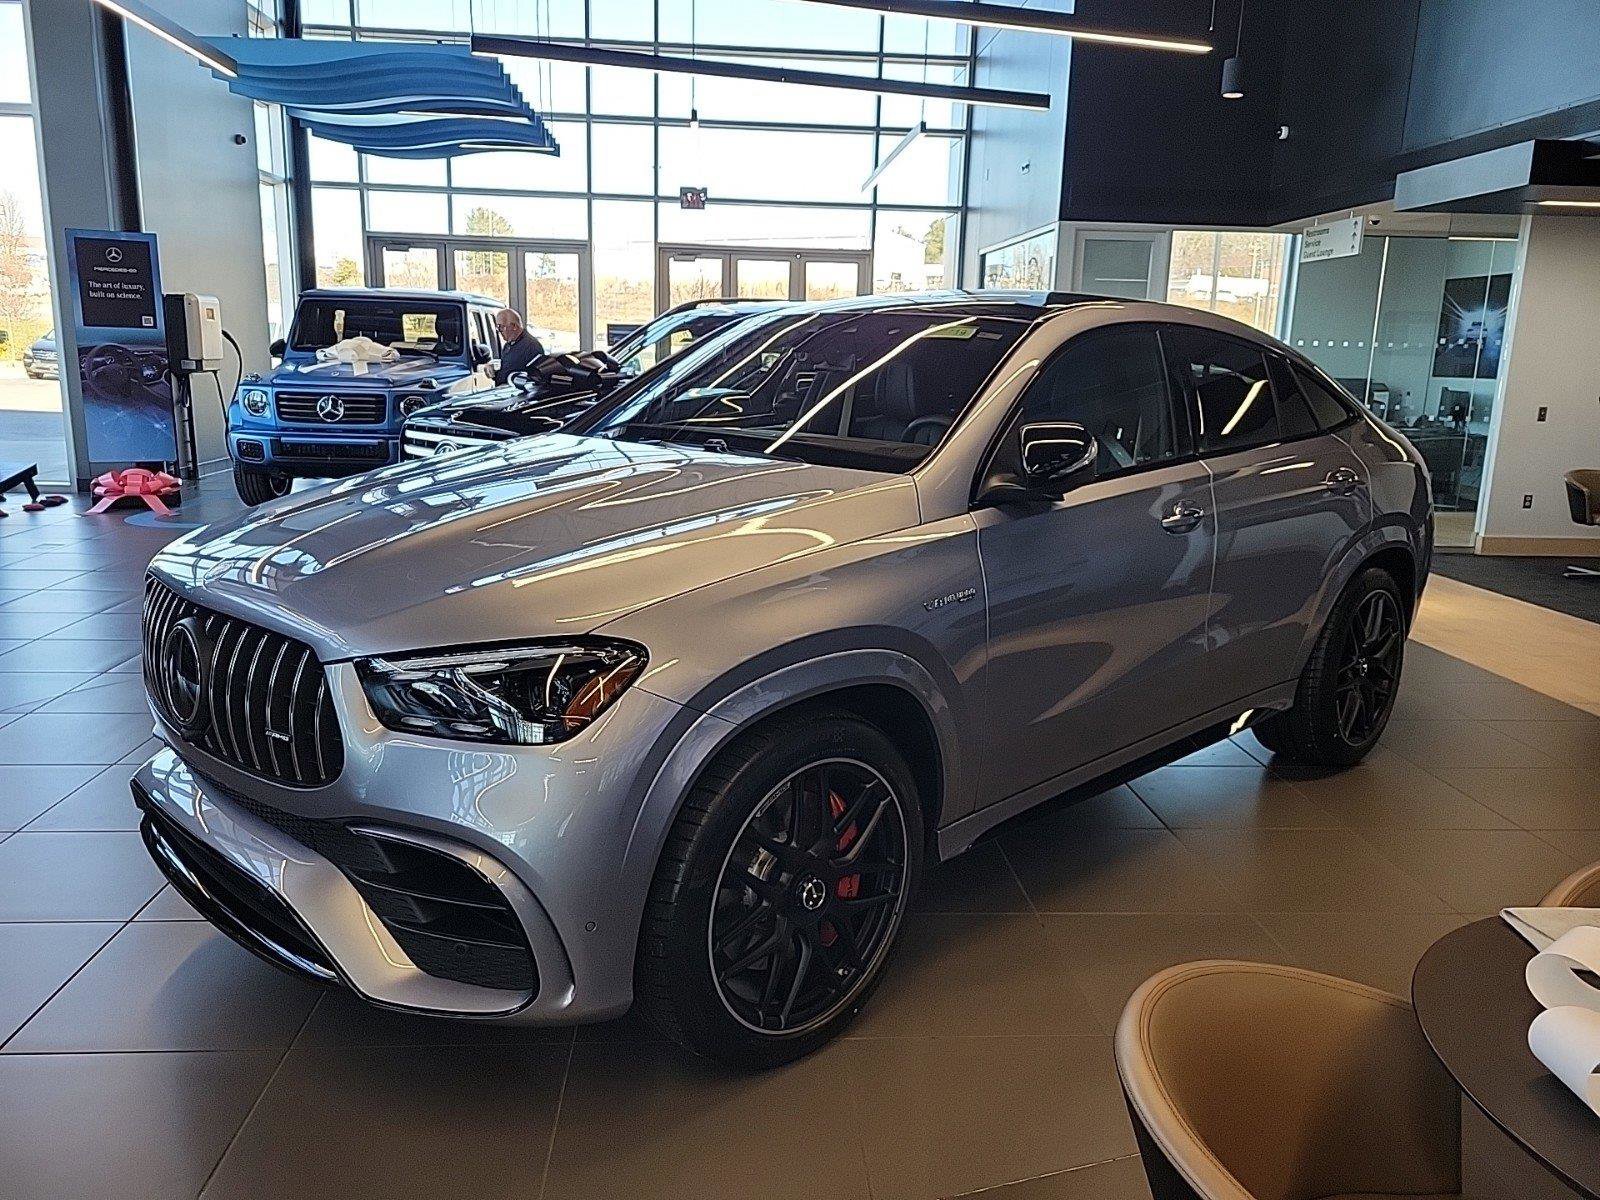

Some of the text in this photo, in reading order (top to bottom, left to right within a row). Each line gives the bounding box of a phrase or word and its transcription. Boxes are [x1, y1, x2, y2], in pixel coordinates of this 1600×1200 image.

[88, 280, 101, 288] The
[121, 282, 146, 291] luxury,
[89, 290, 105, 298] built
[116, 292, 142, 300] science.
